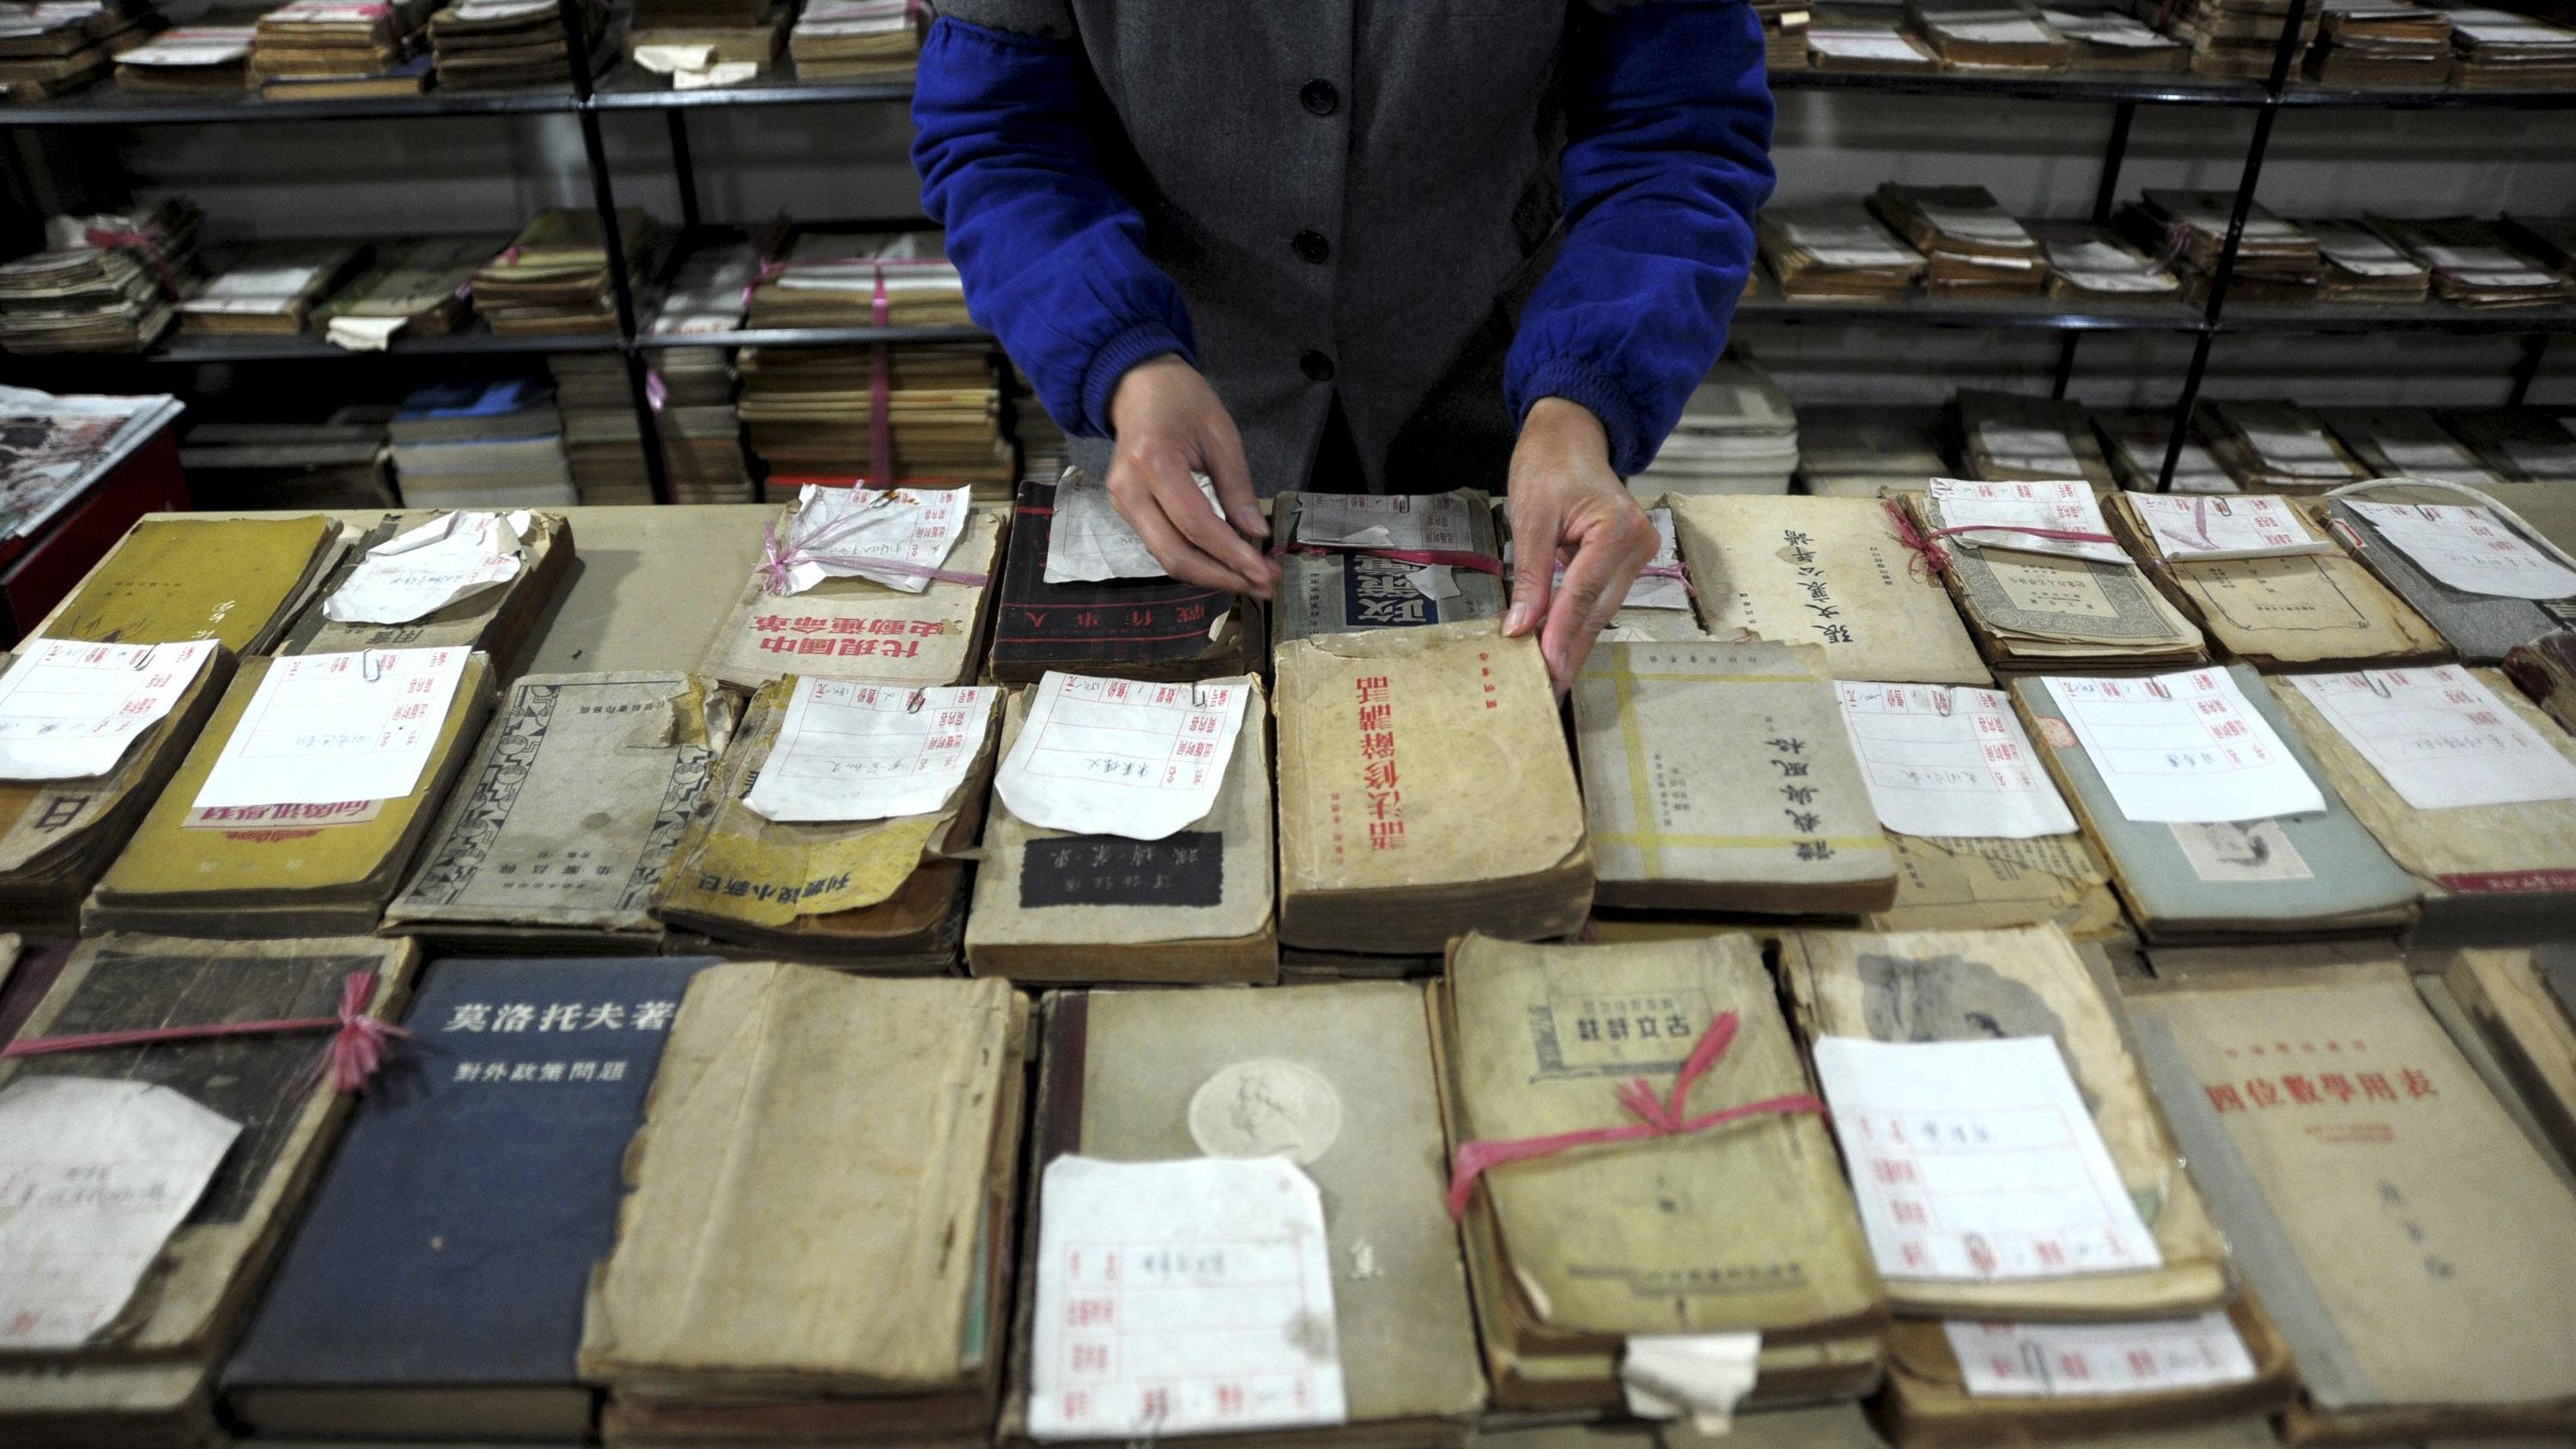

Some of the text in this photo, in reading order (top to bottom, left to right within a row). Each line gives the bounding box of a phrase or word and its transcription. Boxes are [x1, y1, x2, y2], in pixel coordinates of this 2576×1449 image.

[1784, 530, 1853, 643] 張文襄公年譜
[749, 615, 941, 637] 革命運動史
[760, 636, 919, 658] 中國現代
[1108, 681, 1127, 703] 售价
[1156, 687, 1176, 704] 数量
[1210, 689, 1229, 708] 编号
[1176, 740, 1212, 758] 出版时间
[1356, 676, 1406, 851] 語法修辭講話
[442, 1001, 675, 1033] 莫洛托夫著
[453, 1060, 628, 1082] 對外政策問題
[2206, 1068, 2438, 1113] 四位數學用表
